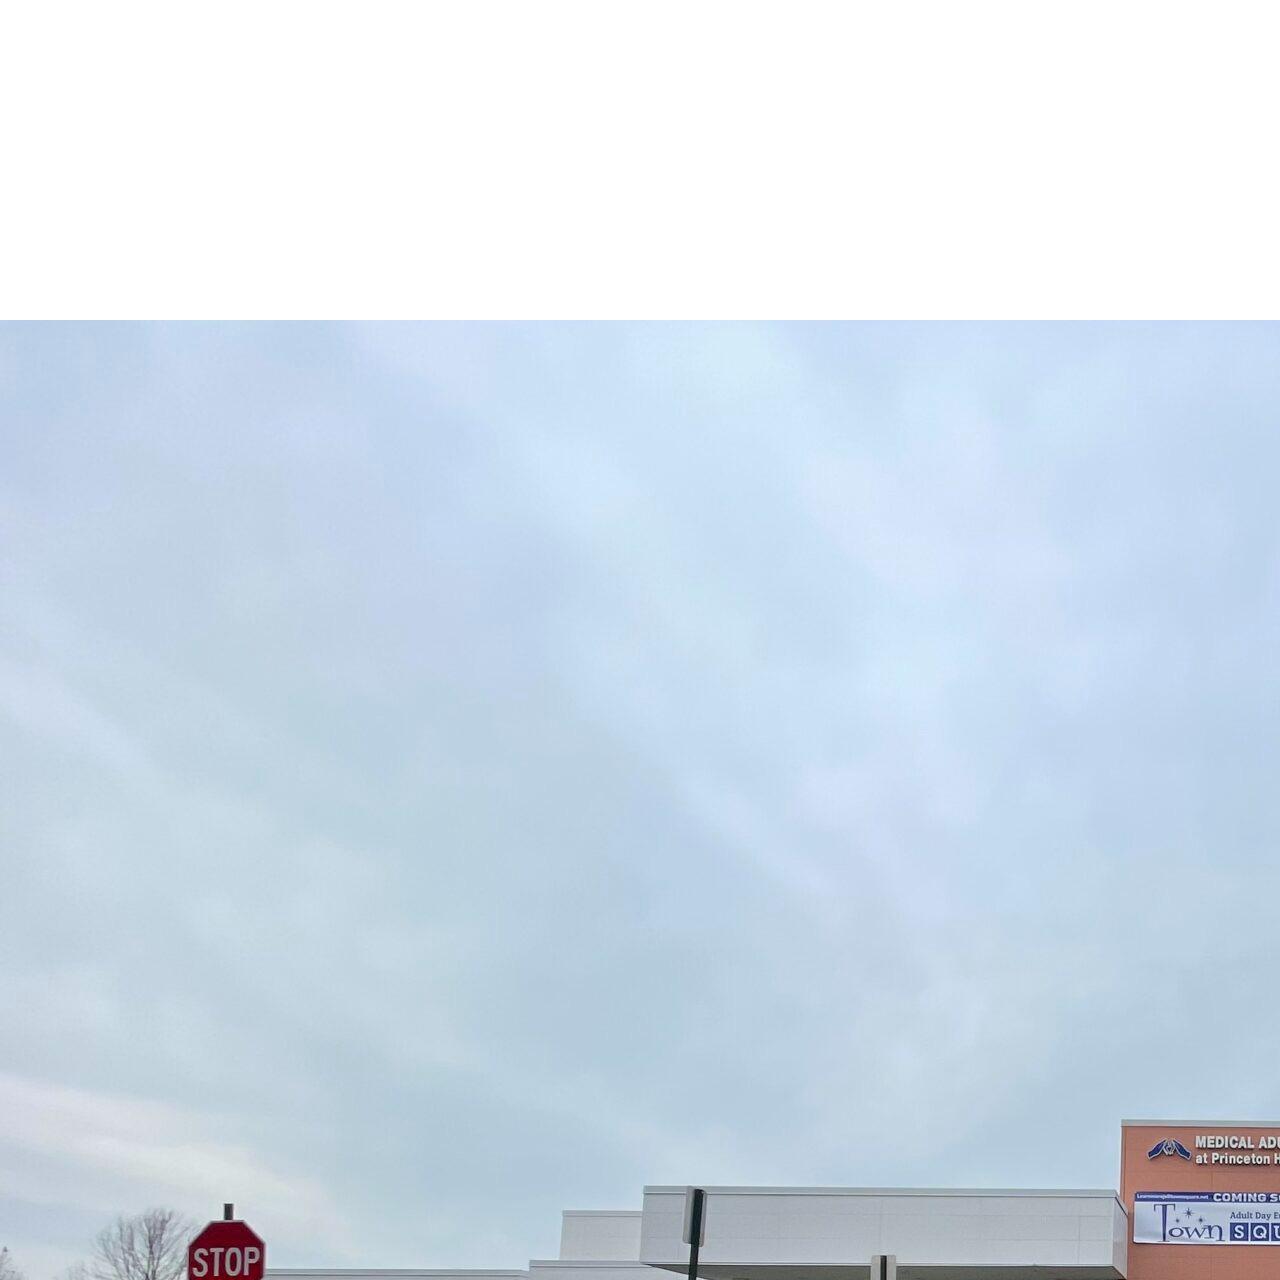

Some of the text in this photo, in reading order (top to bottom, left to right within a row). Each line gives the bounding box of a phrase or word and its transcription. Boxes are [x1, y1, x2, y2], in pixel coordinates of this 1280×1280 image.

[1195, 1135, 1254, 1149] MEDICAL
[1195, 1153, 1208, 1164] at
[1211, 1153, 1270, 1165] Princeton
[1213, 1193, 1267, 1202] COMING
[1153, 1203, 1226, 1242] Town
[1230, 1211, 1253, 1220] Adult
[1255, 1212, 1271, 1222] Day
[192, 1246, 261, 1278] STOP
